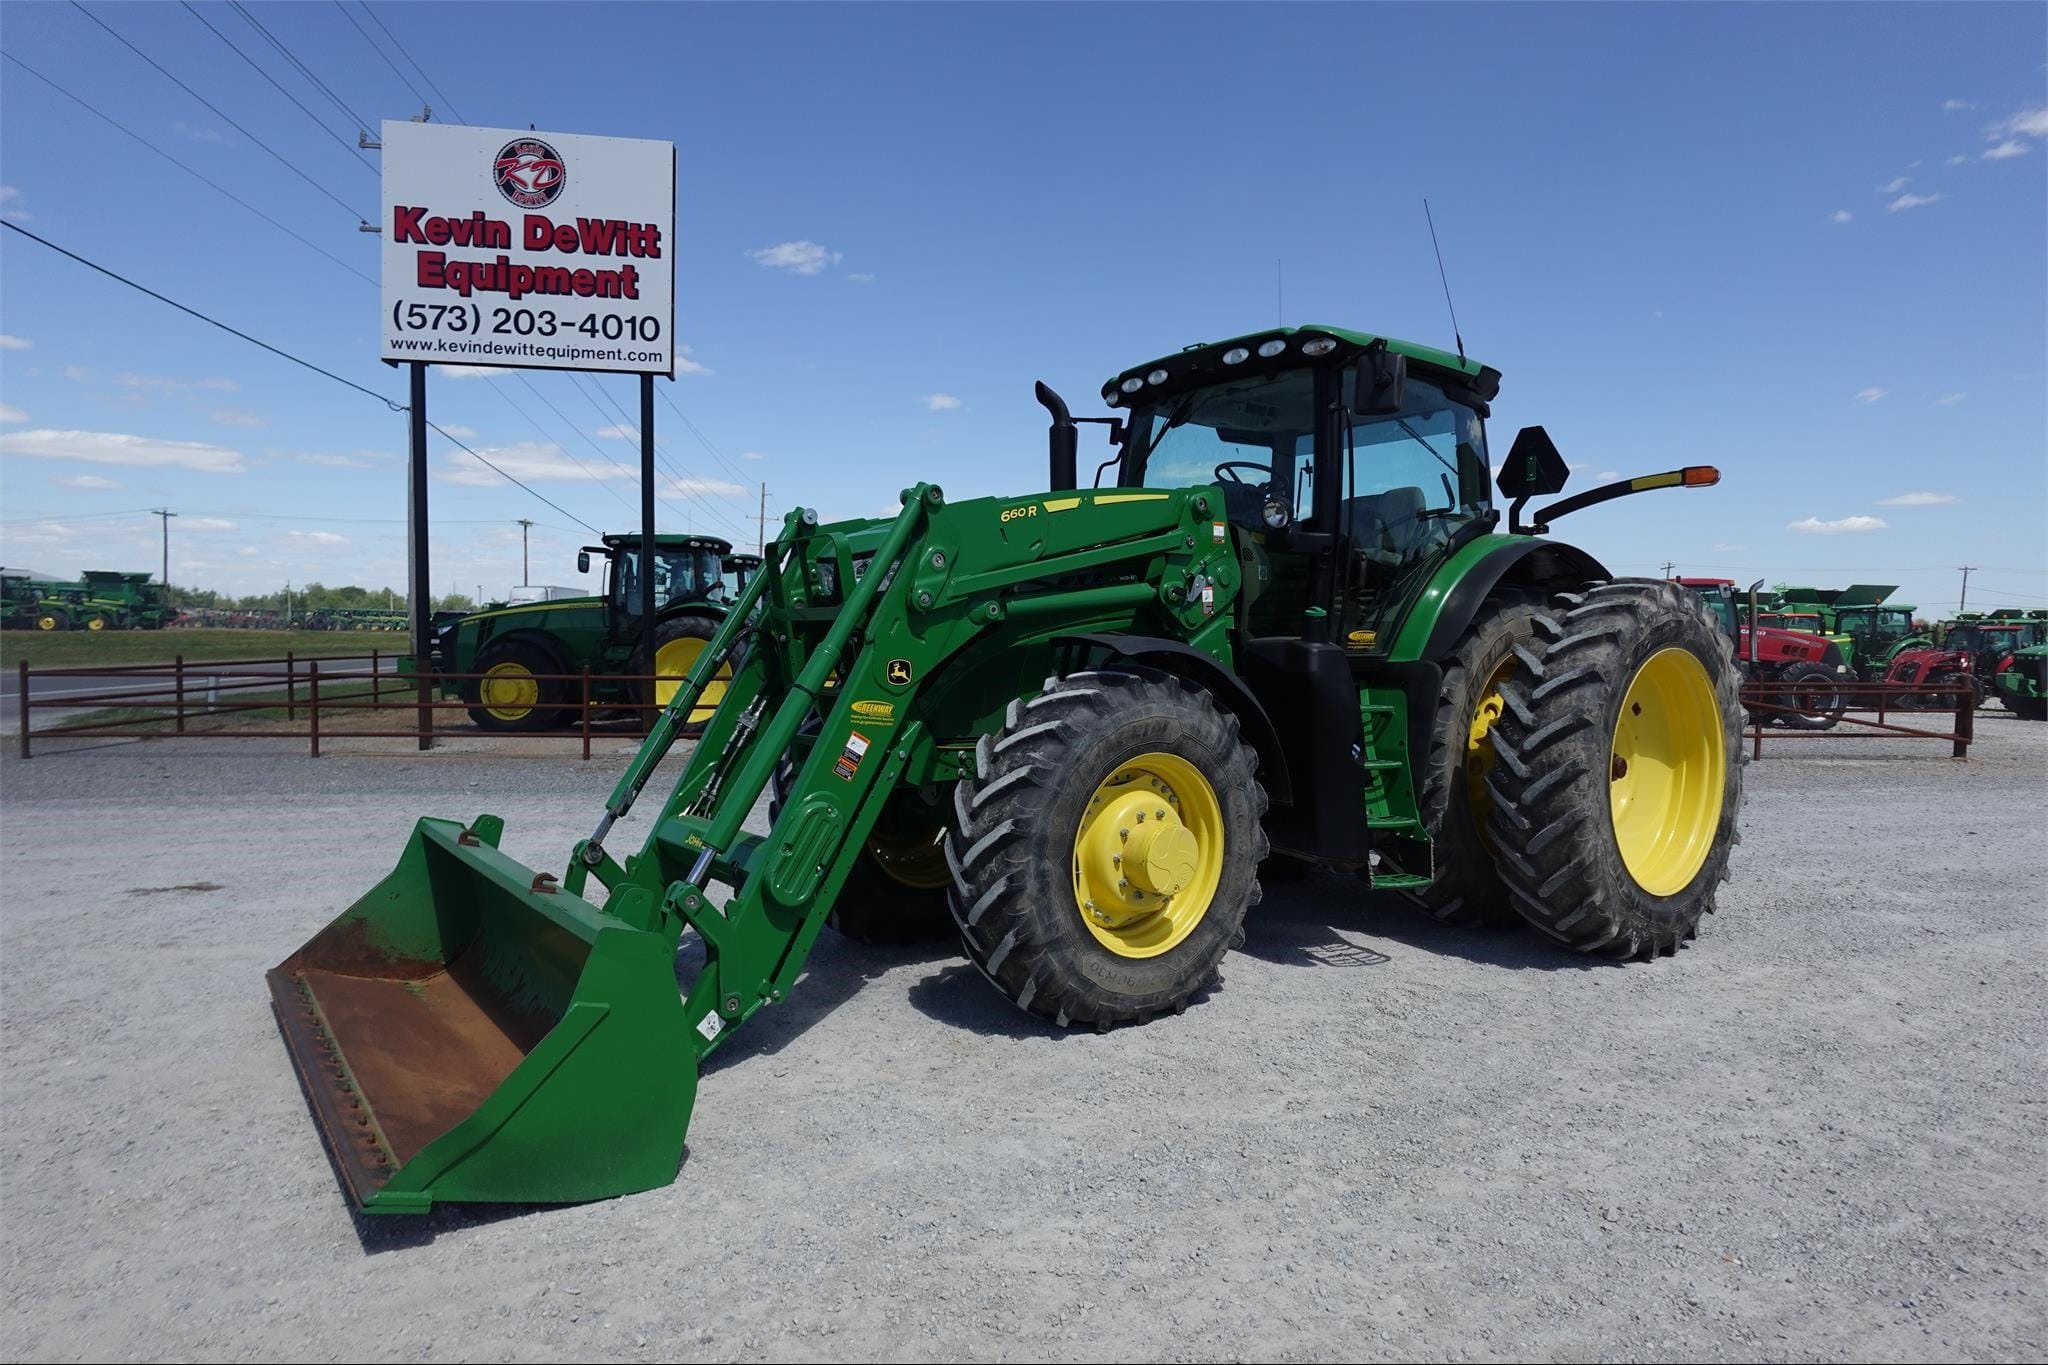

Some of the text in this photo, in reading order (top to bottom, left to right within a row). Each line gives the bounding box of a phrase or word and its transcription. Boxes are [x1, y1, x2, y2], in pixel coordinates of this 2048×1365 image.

[496, 158, 563, 189] KD
[393, 204, 662, 259] Kevin DeWitt
[416, 250, 640, 301] Equipment
[393, 300, 661, 342] (573) 203-4010
[390, 338, 663, 363] www.kevindewittequipment.com
[1000, 505, 1037, 522] 660 R
[856, 703, 894, 714] GREENWAY
